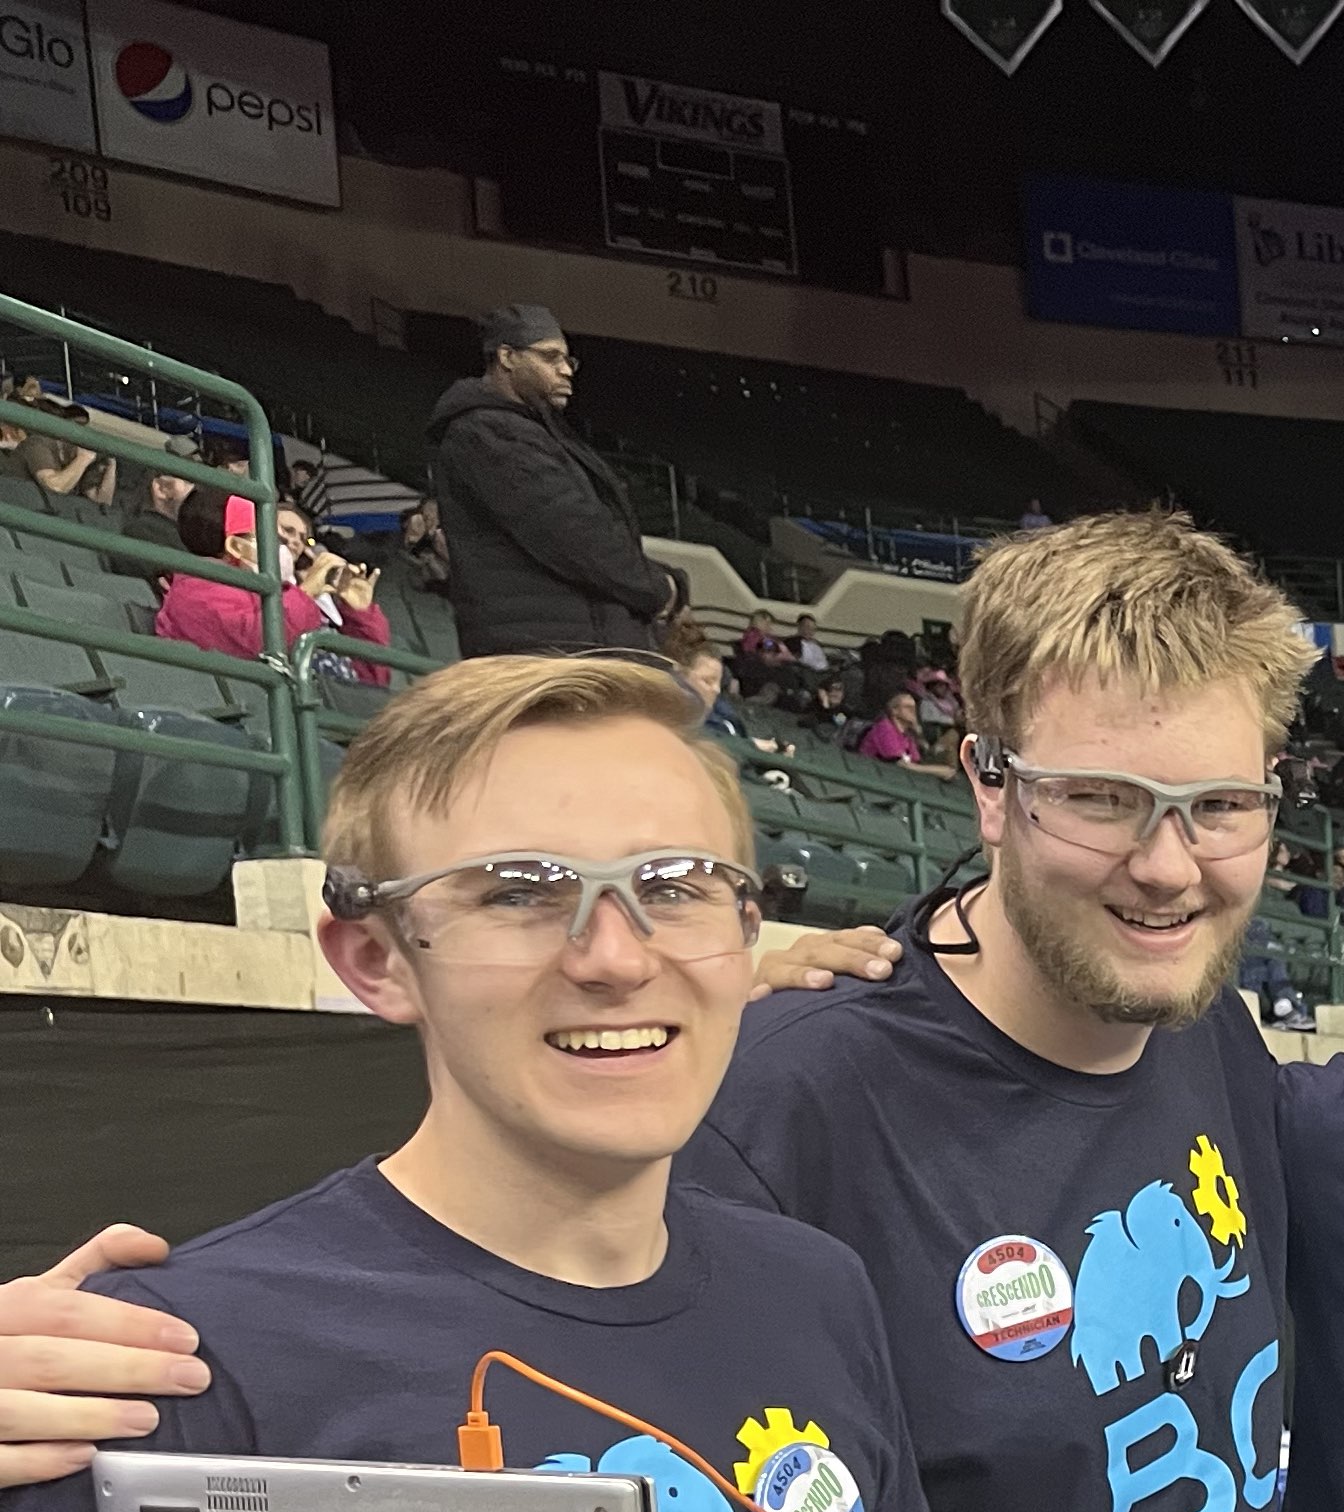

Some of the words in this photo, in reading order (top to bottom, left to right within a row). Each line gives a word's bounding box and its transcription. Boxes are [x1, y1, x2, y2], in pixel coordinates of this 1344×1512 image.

[206, 82, 322, 136] pepsi
[667, 269, 718, 301] 210
[987, 1245, 1025, 1266] 4504
[976, 1263, 1057, 1308] CRESCENDO
[993, 1315, 1061, 1342] TECHNICIAN
[771, 1456, 802, 1497] 4504
